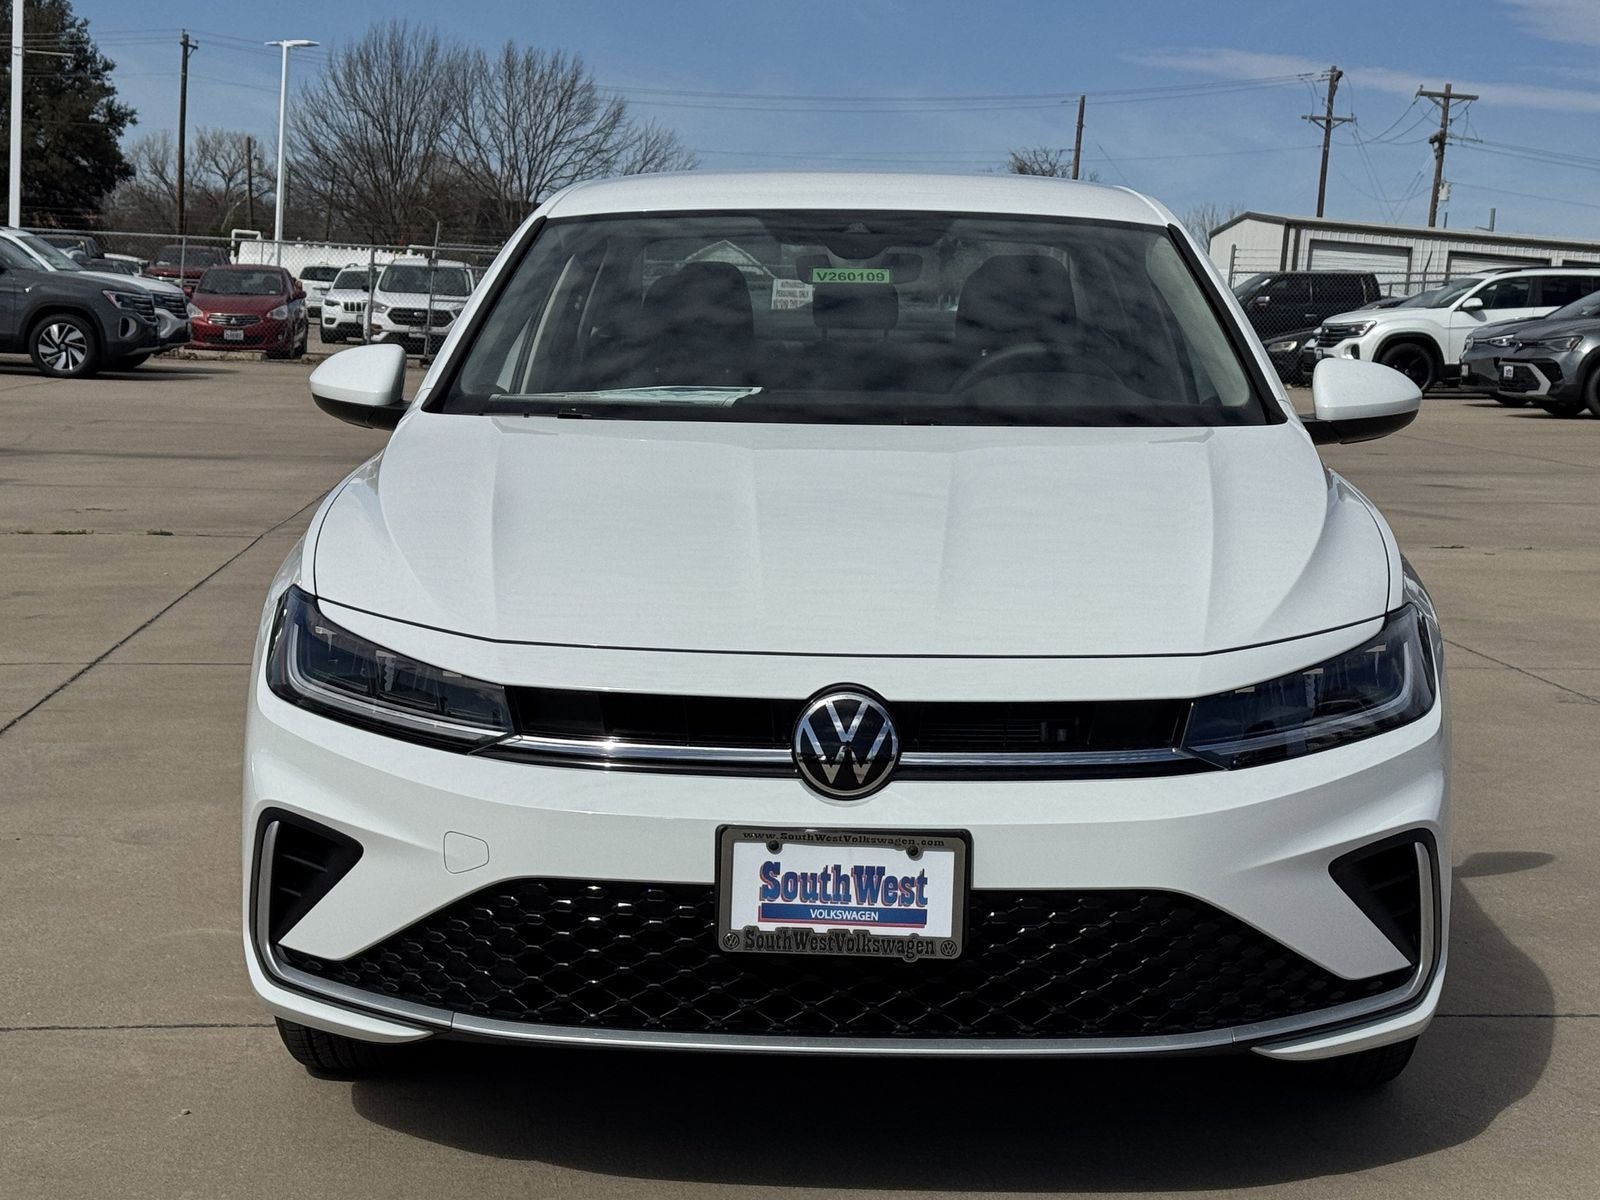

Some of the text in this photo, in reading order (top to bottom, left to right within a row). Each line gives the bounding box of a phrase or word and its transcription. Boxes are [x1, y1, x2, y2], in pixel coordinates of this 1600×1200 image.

[816, 271, 885, 282] V260109
[743, 832, 945, 847] www.SouthWestVolkswagen.com
[759, 860, 928, 907] SouthWest
[810, 908, 879, 921] VOLKSWAGEN
[745, 929, 936, 959] SouthWestVolkswagen
